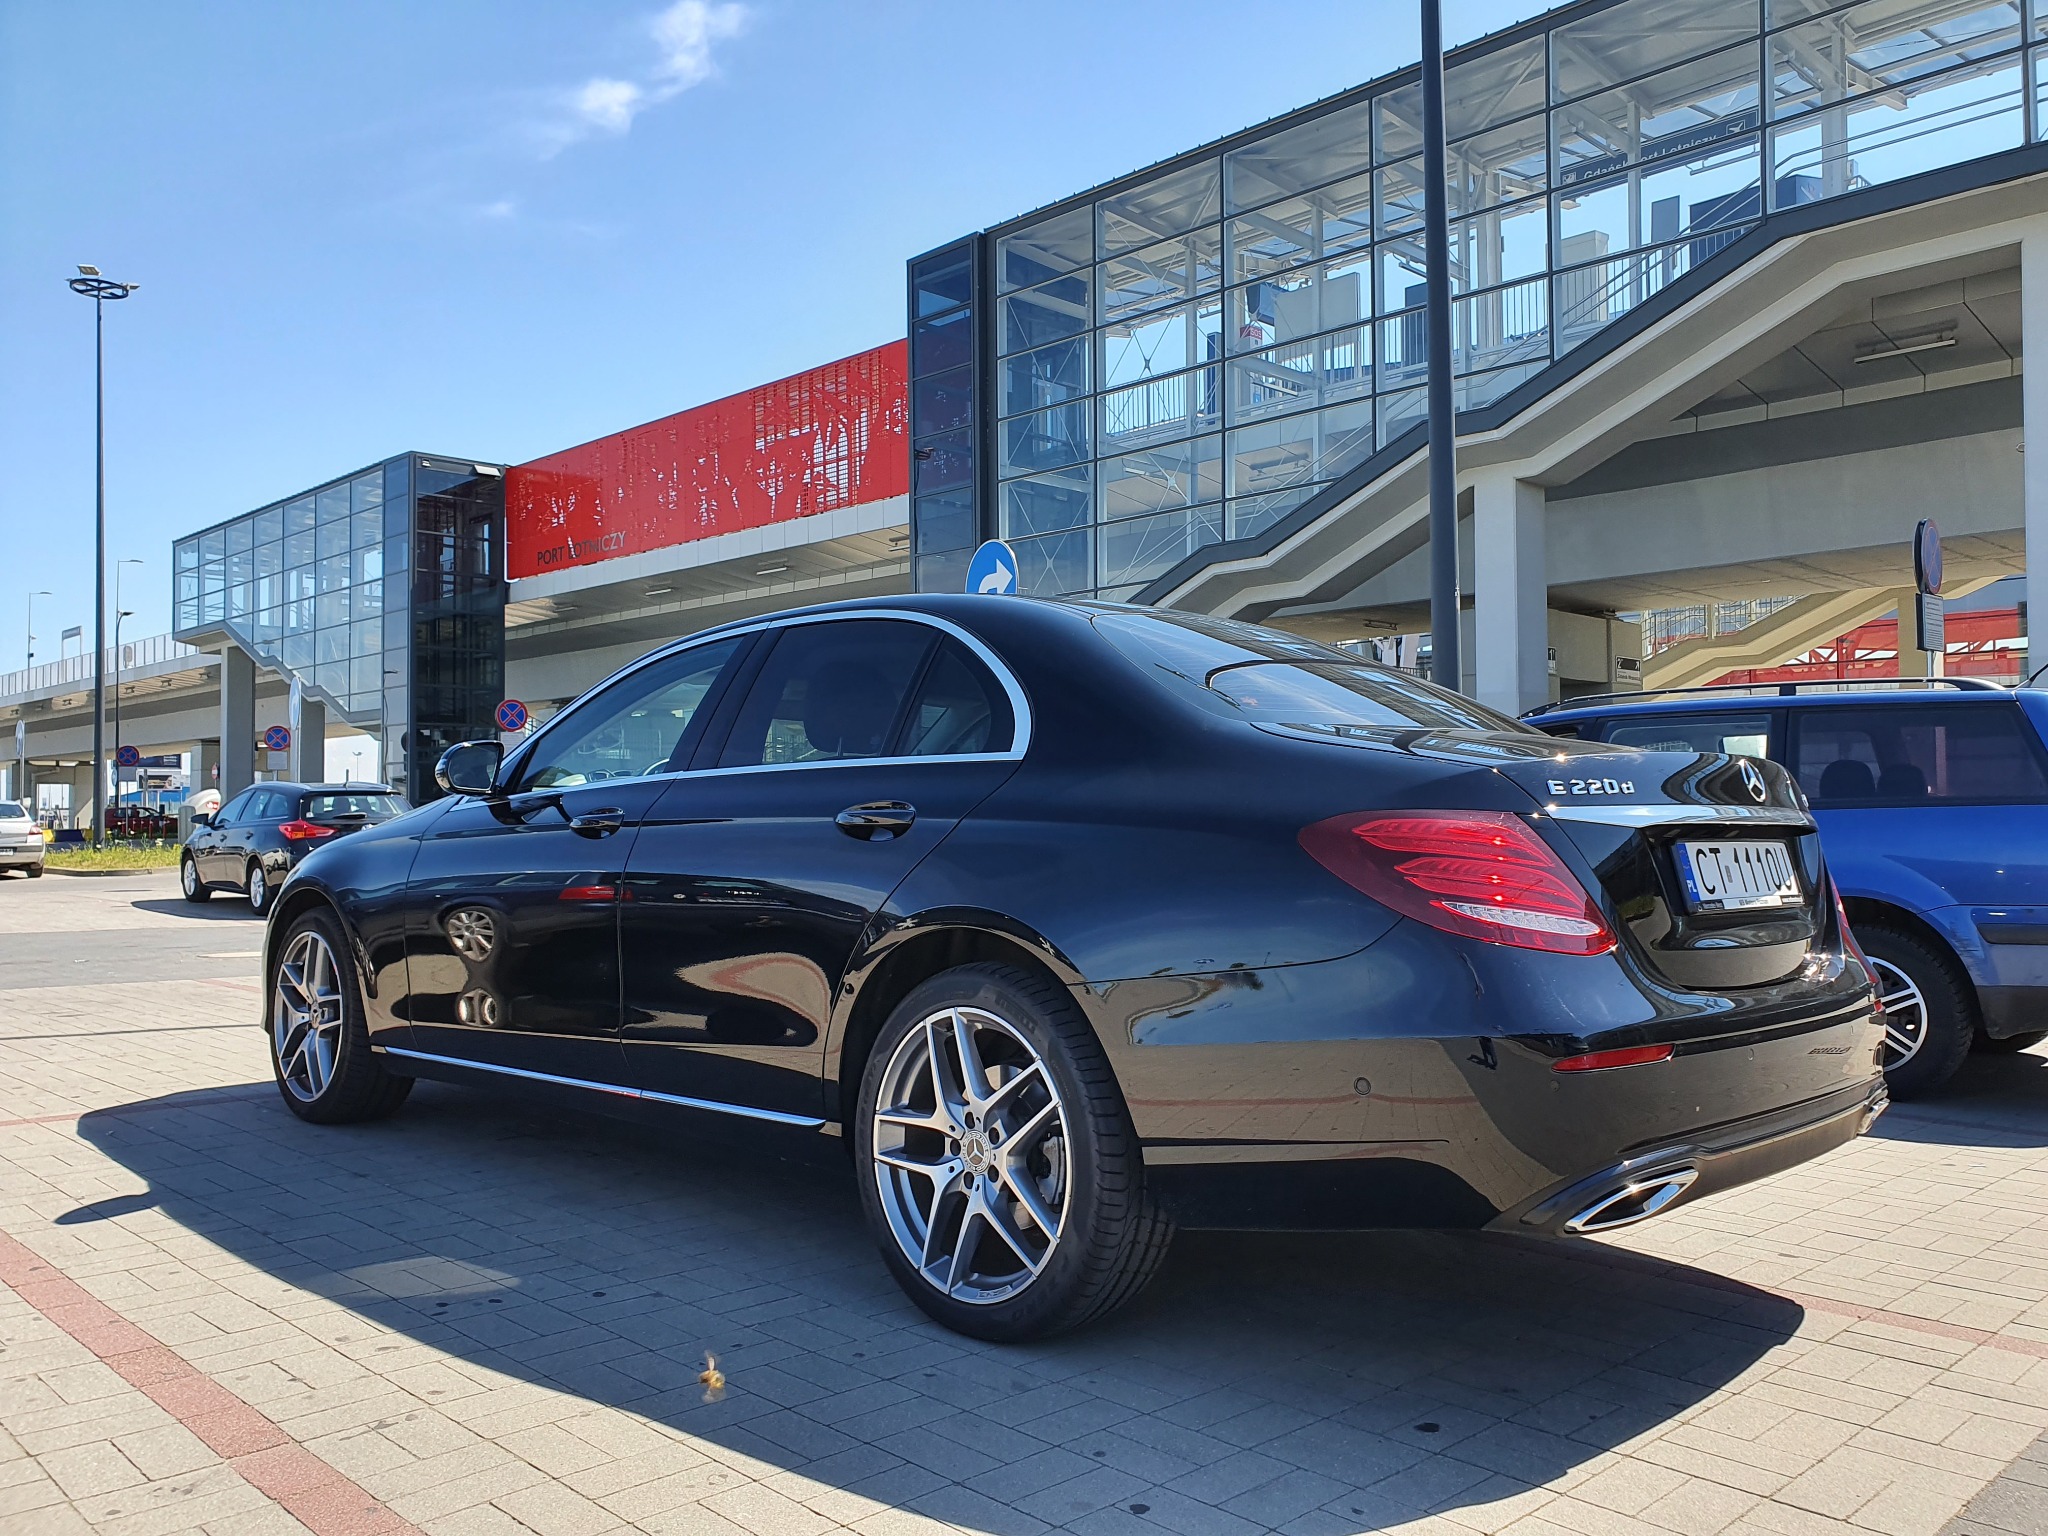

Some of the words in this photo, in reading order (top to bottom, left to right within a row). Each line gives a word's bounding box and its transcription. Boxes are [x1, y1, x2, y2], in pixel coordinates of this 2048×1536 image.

[537, 546, 565, 566] PORT
[1546, 779, 1567, 795] E
[1569, 778, 1635, 795] 220d
[1696, 847, 1728, 895] CT
[1687, 879, 1698, 893] PL
